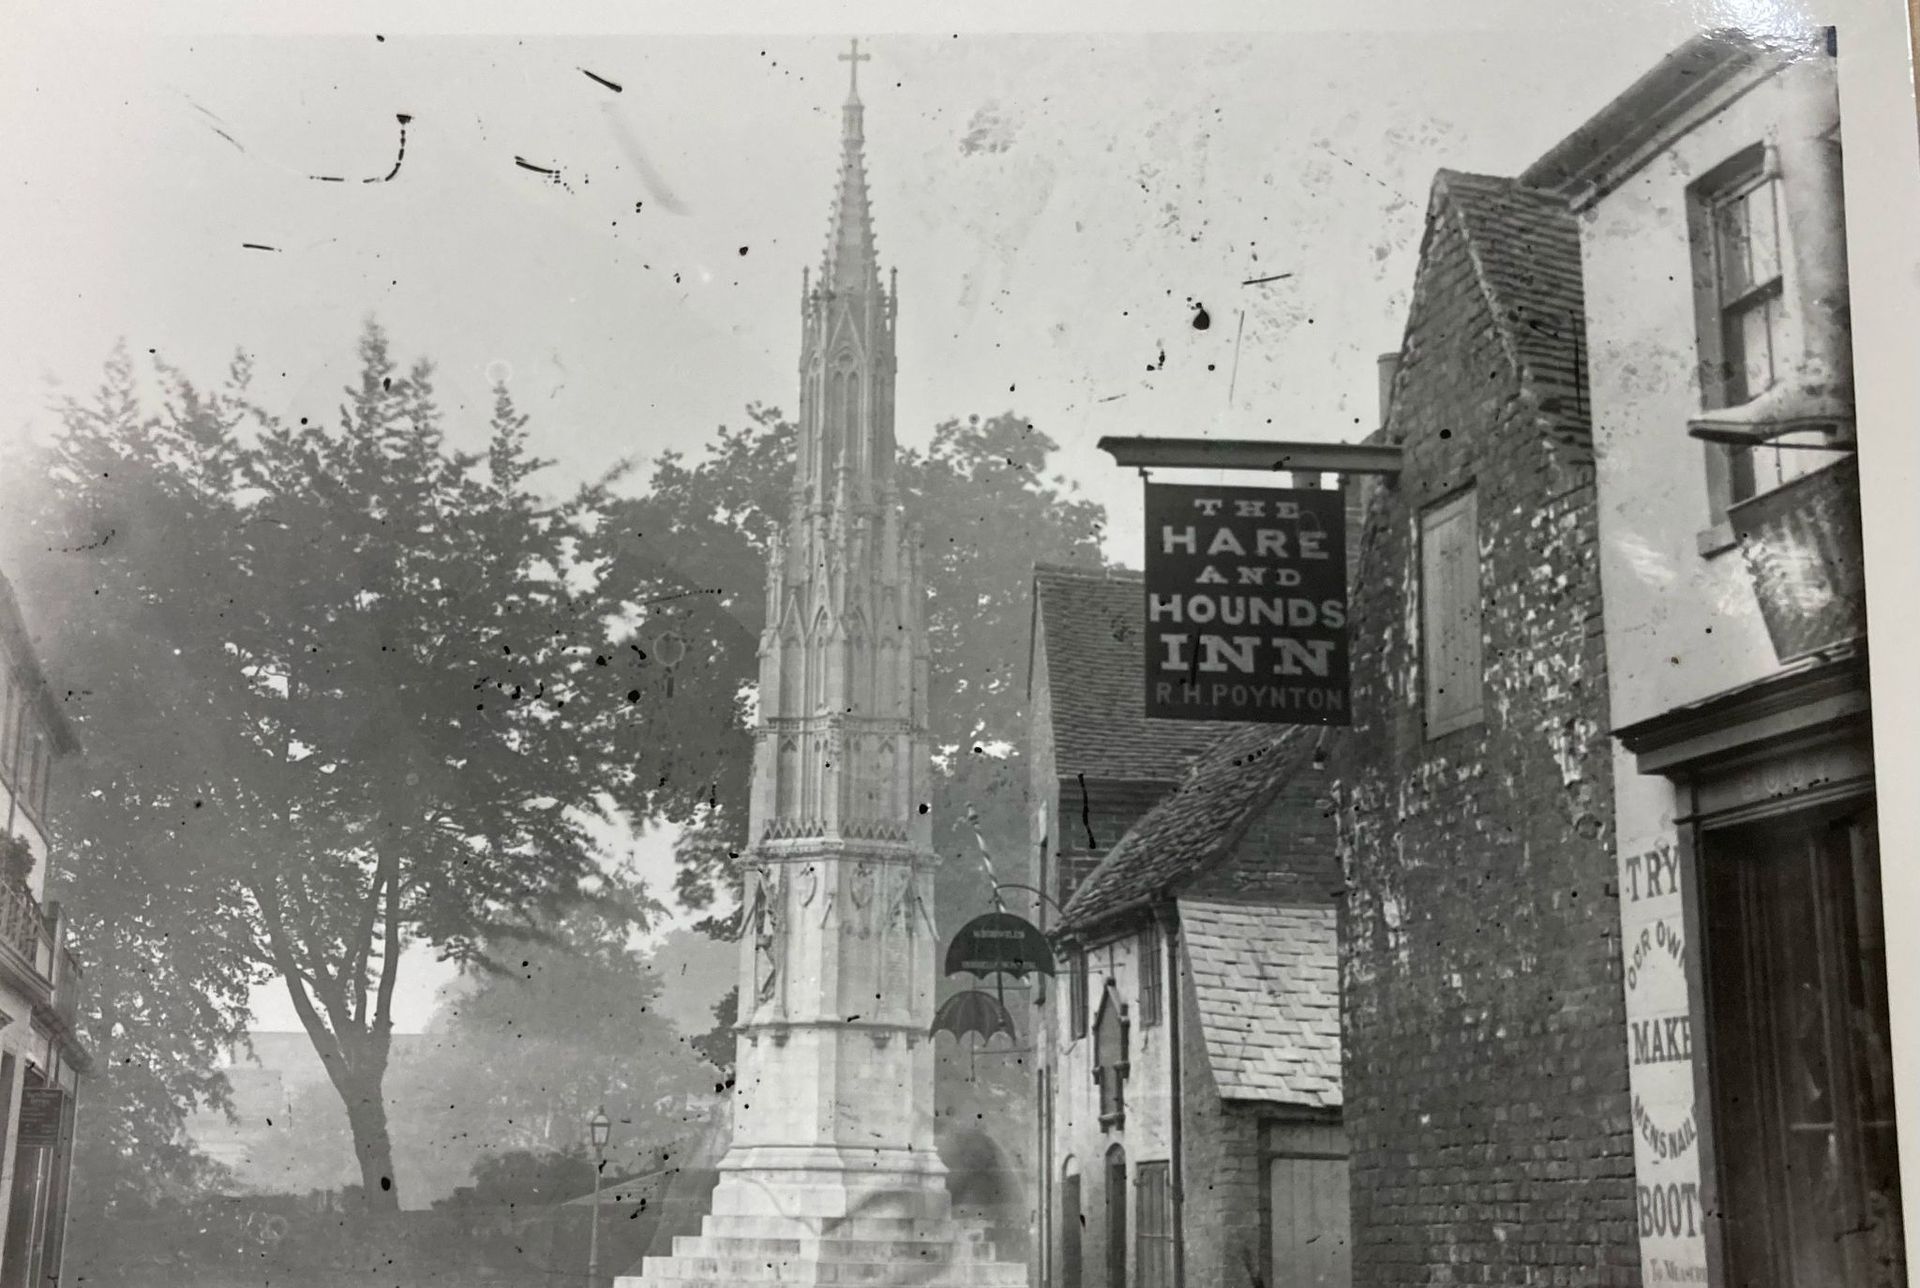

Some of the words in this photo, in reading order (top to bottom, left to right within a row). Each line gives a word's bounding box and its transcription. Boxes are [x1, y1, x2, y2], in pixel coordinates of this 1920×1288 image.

[1193, 498, 1301, 519] THE
[1161, 525, 1329, 559] HARE
[1195, 565, 1302, 586] AND
[1149, 593, 1346, 629] HOUNDS
[1160, 632, 1336, 677] INN
[1211, 683, 1343, 711] POYNTON
[1625, 845, 1679, 902] TRY
[1631, 1016, 1692, 1065] MAKE
